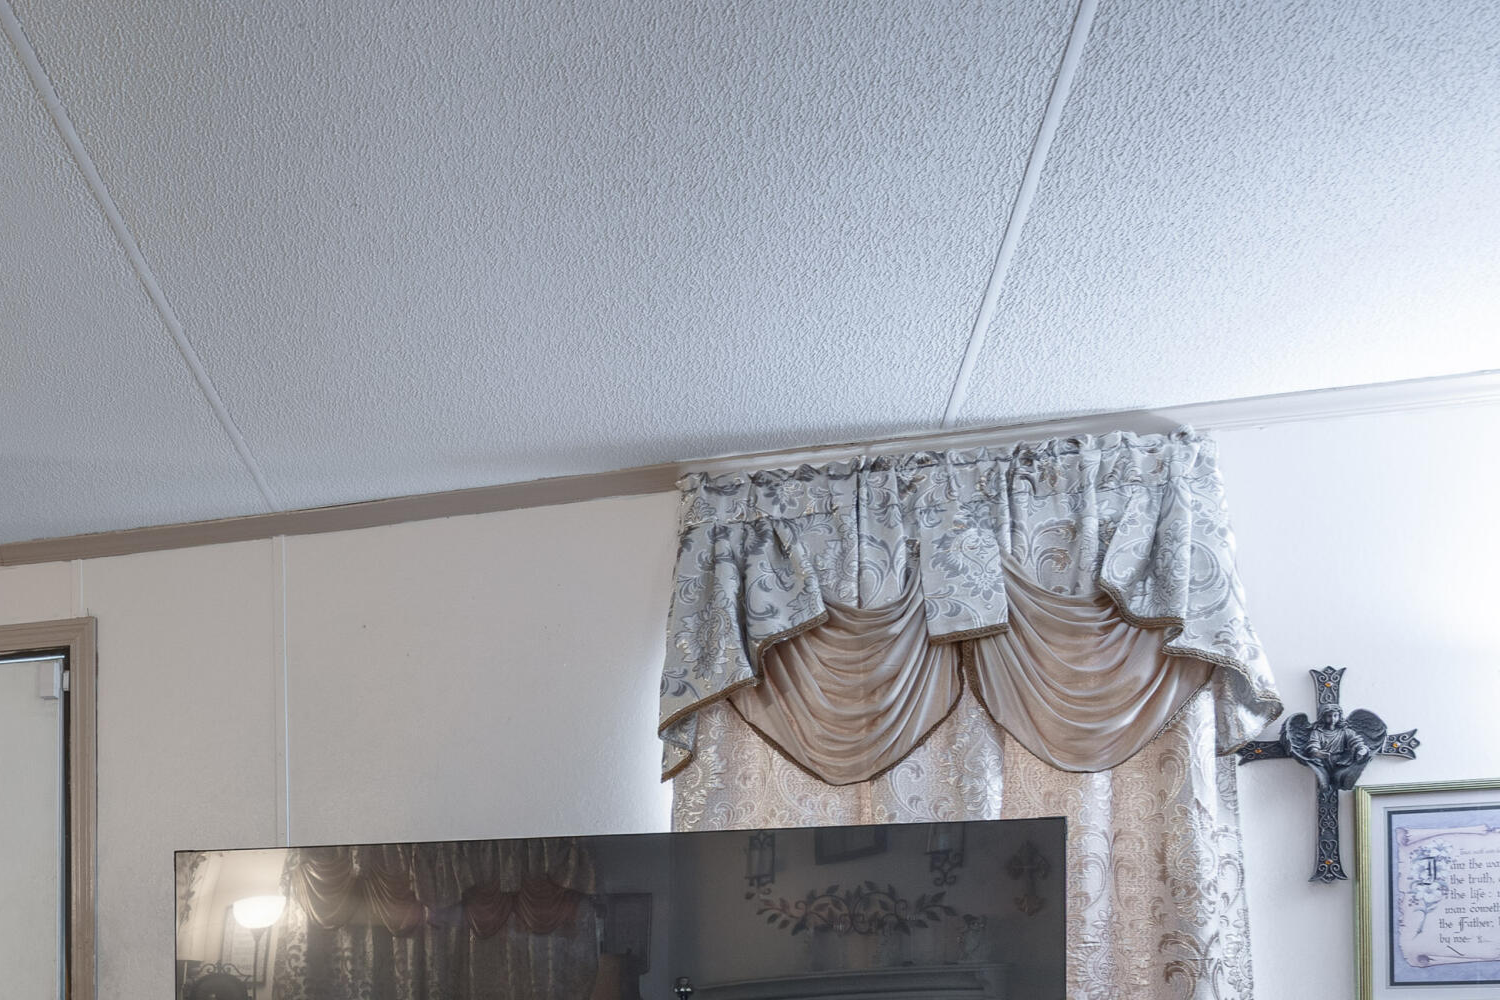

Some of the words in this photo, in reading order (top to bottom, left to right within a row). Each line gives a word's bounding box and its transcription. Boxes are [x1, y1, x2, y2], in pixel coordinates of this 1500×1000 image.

[1469, 858, 1482, 869] the
[1450, 874, 1465, 885] the
[1450, 888, 1465, 899] the
[1439, 918, 1453, 928] the
